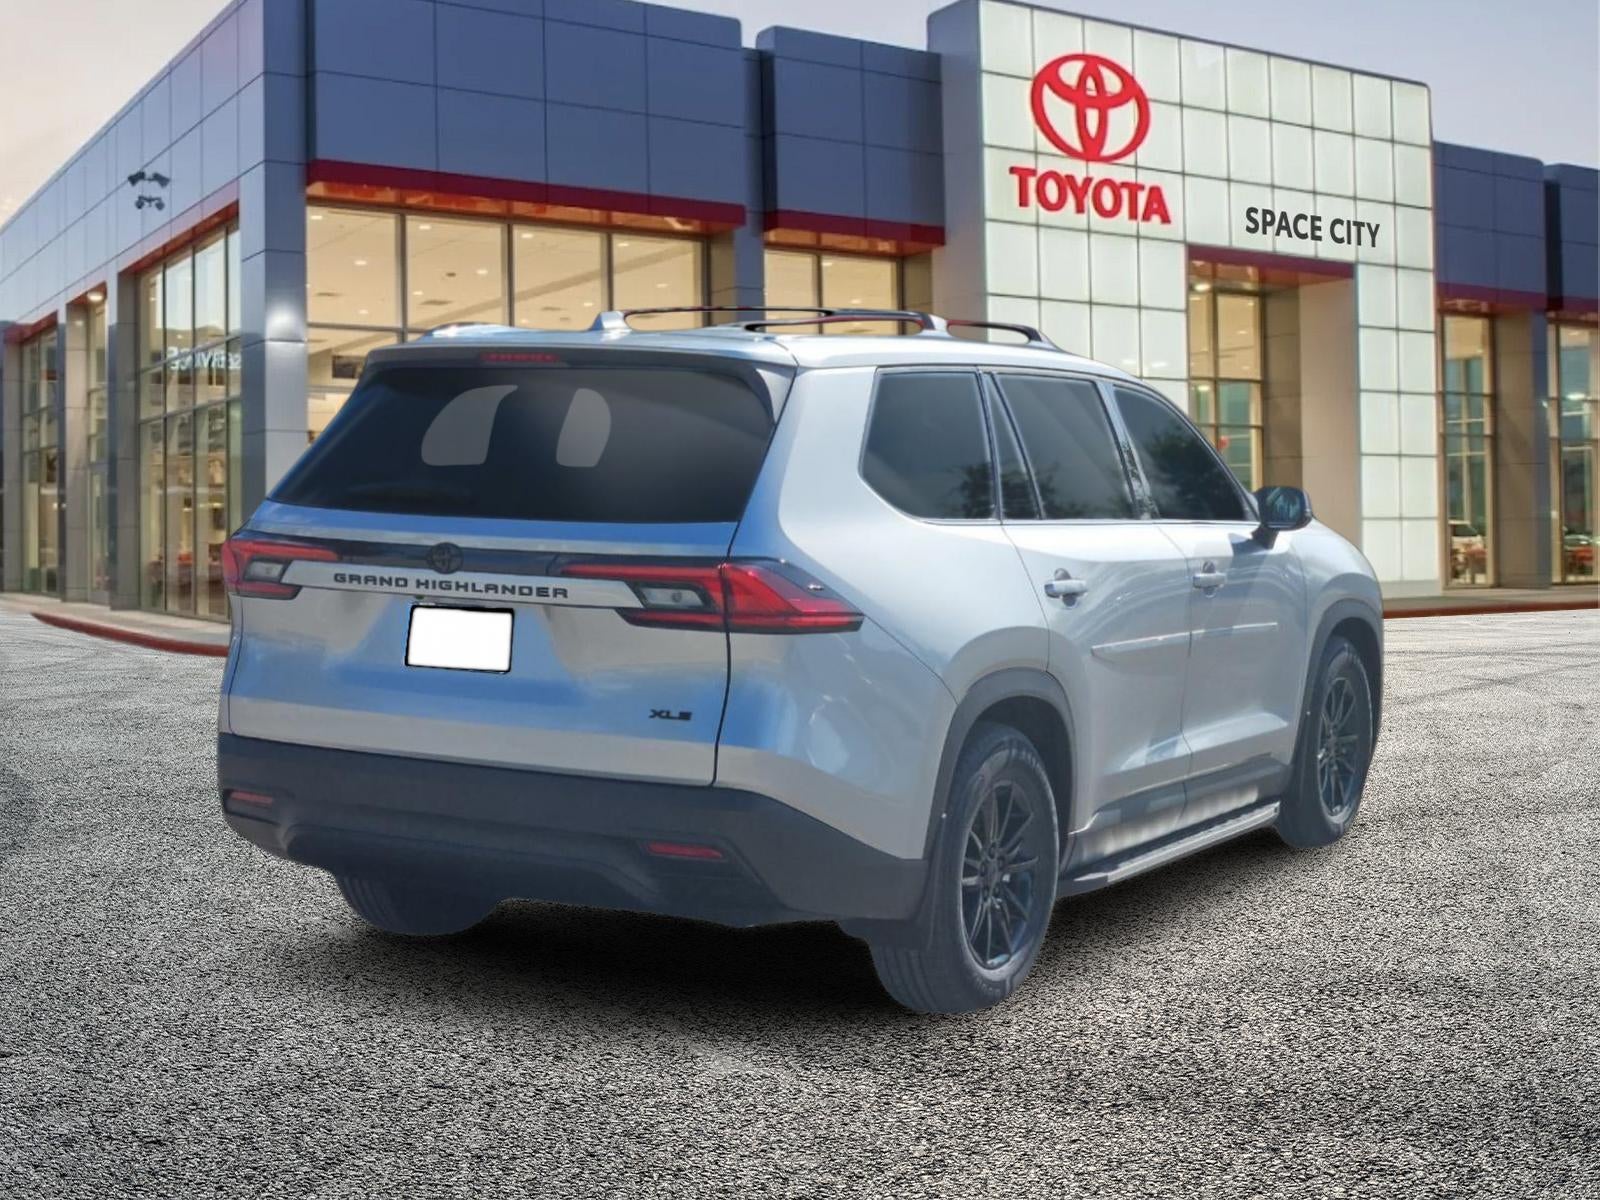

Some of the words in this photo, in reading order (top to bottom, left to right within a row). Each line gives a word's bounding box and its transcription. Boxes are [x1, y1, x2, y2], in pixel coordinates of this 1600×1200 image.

[1009, 166, 1171, 224] TOYOTA
[1245, 206, 1323, 241] SPACE
[1329, 218, 1380, 248] CITY
[333, 572, 409, 588] GRAND
[415, 577, 569, 599] HIGHLANDER
[648, 708, 693, 721] XLE
